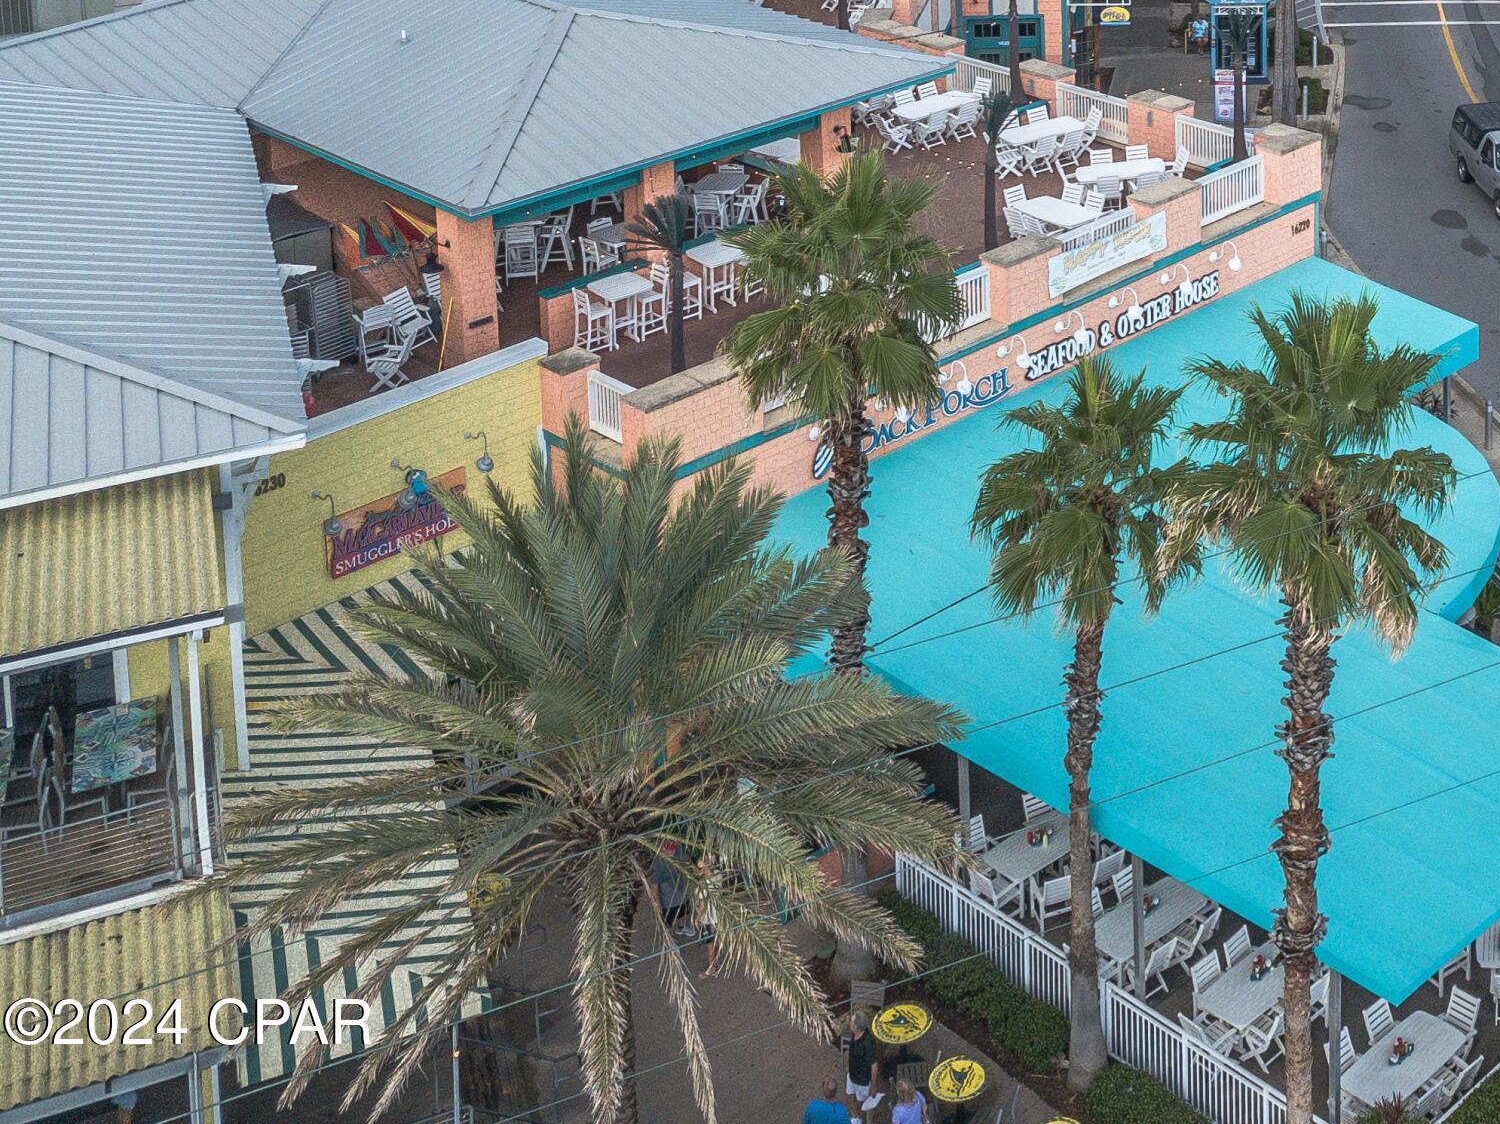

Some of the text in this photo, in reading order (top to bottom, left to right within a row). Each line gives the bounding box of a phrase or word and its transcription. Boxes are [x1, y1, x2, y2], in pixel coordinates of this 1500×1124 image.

[1026, 271, 1220, 380] SEAFOOD & OYSTER HOUSE
[334, 527, 424, 575] SMUGGLER'S
